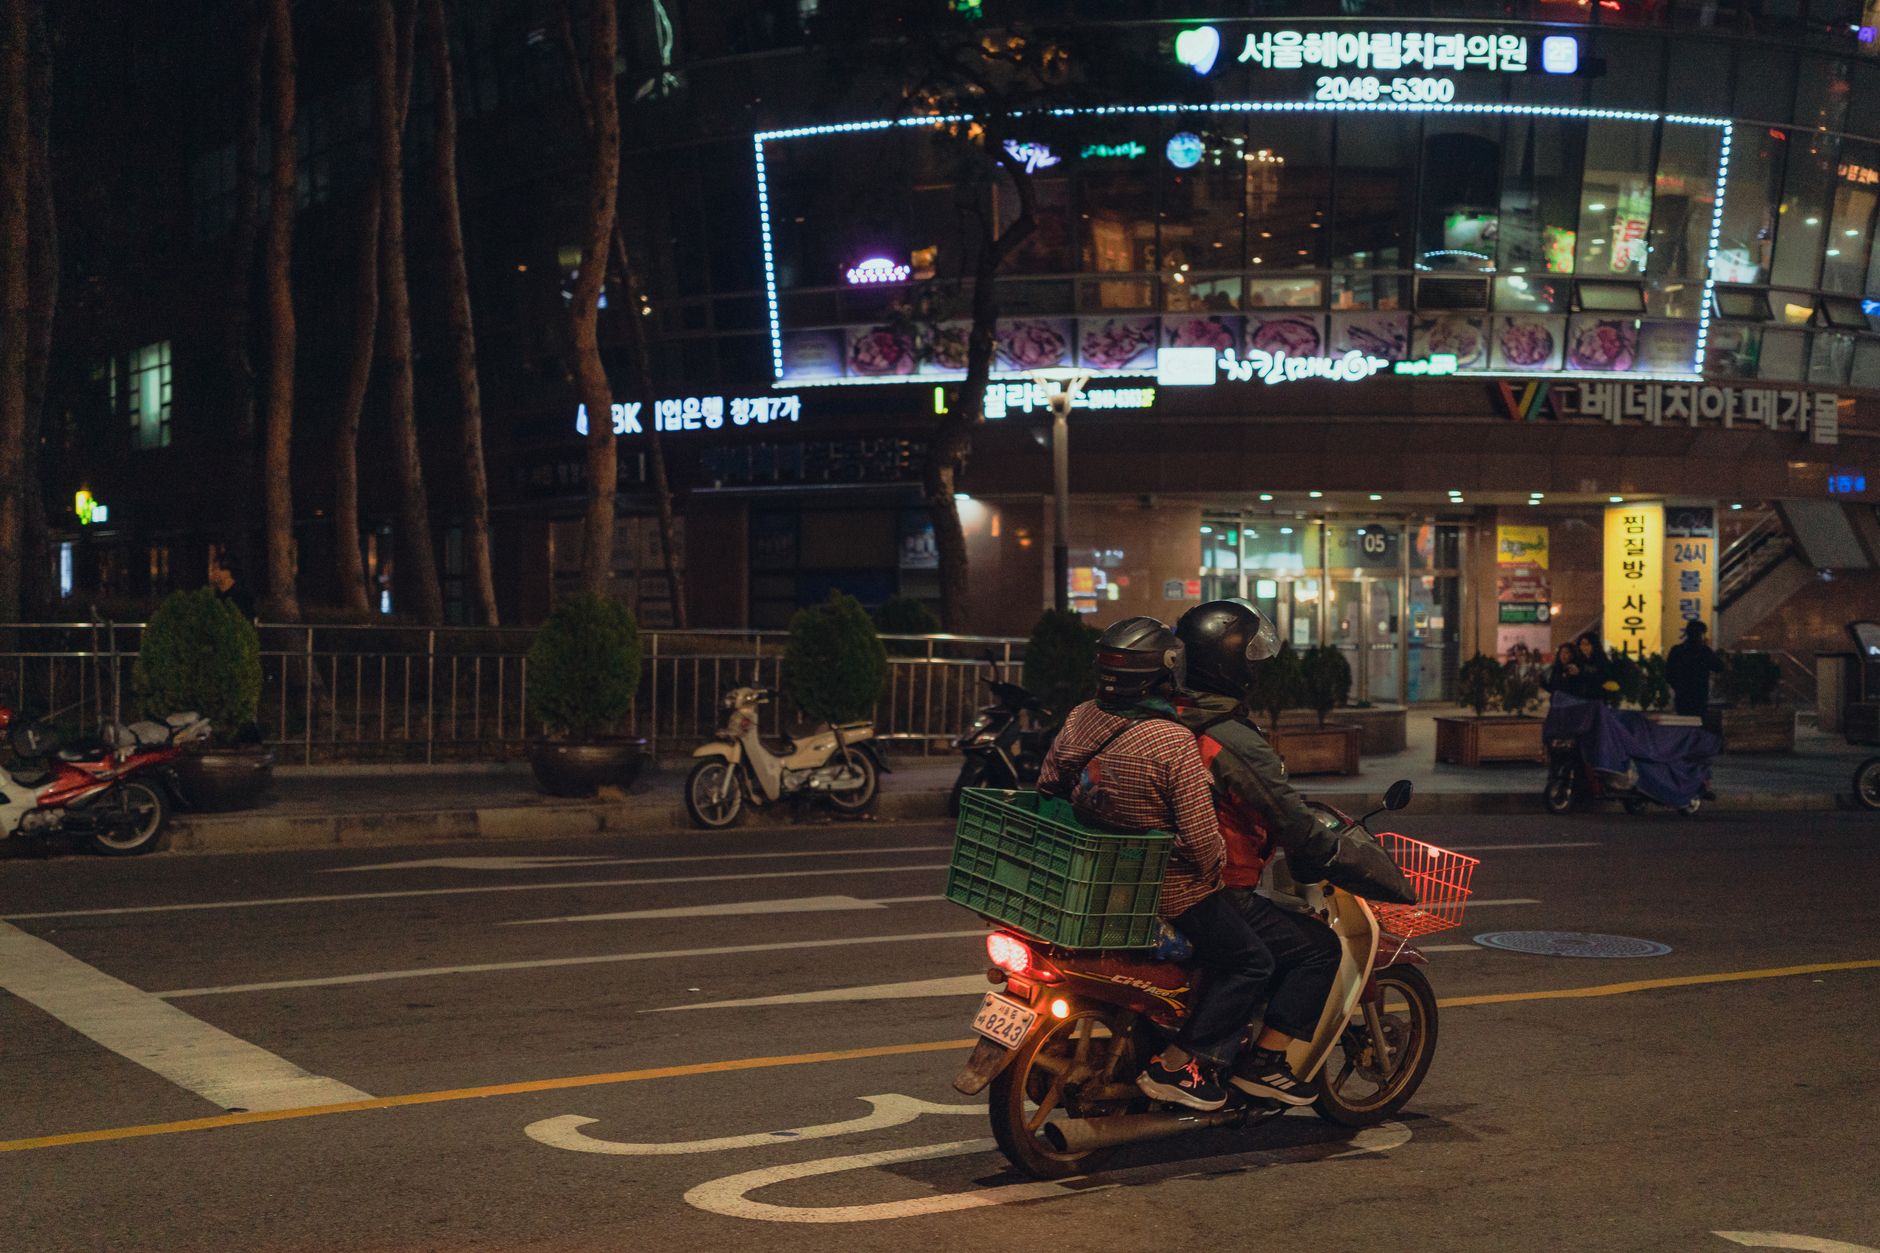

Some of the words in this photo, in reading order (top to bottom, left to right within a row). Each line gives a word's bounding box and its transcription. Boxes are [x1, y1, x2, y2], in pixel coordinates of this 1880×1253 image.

[1238, 31, 1527, 71] 서울헤아림치과의원
[1316, 76, 1455, 102] 2048-5300
[1364, 533, 1386, 553] 05
[1674, 543, 1706, 564] 24시
[1621, 594, 1647, 658] 사우나
[985, 1013, 1023, 1042] 8243
